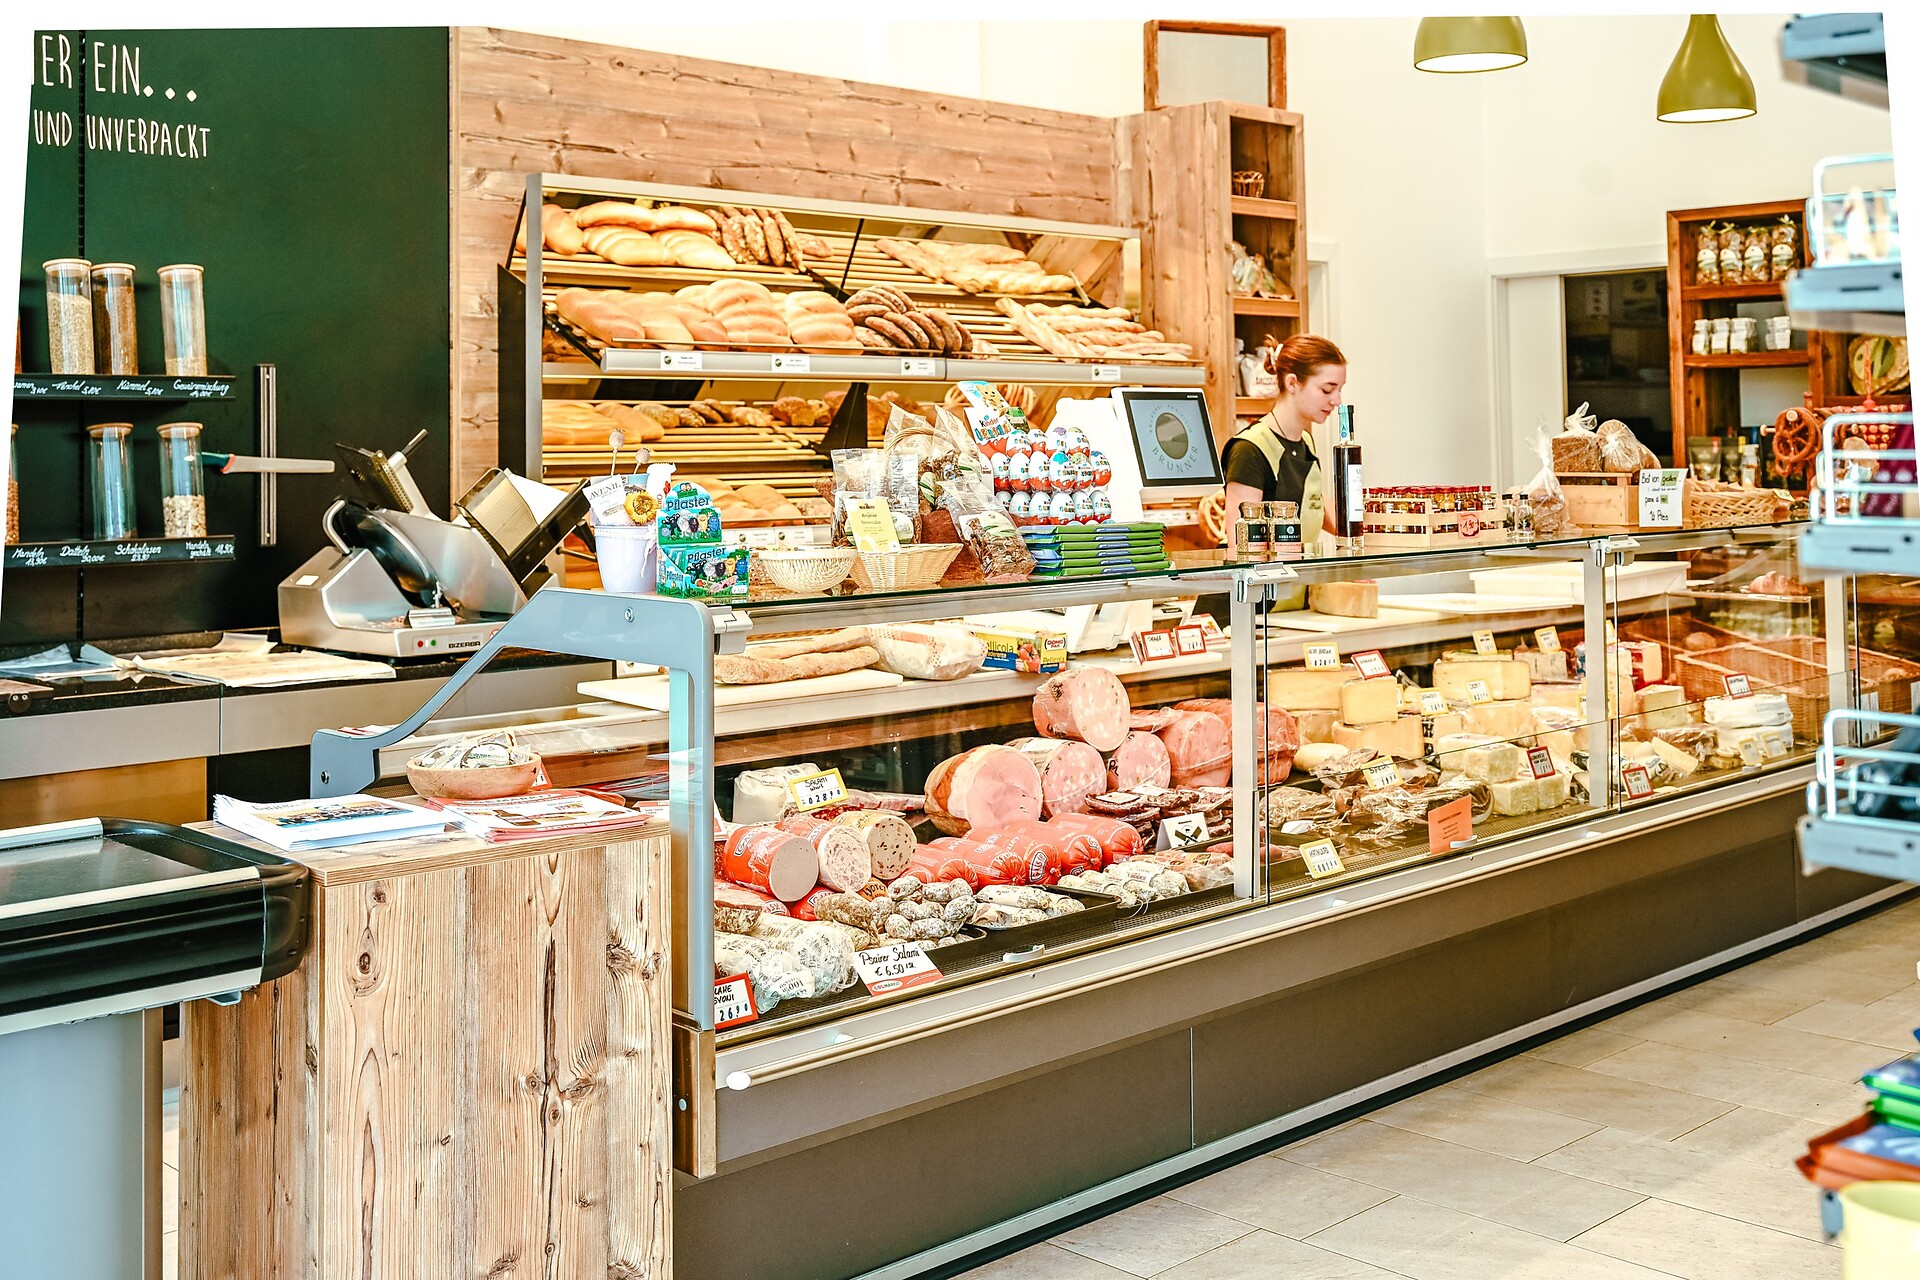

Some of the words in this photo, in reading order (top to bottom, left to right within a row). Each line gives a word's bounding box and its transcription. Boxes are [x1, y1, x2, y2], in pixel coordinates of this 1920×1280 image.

[33, 108, 73, 147] UND
[86, 114, 211, 159] UNVERPACKT
[116, 380, 151, 391] Kümmel
[1152, 445, 1199, 474] BRUNNER
[666, 495, 711, 513] Pflaster
[60, 545, 91, 557] Datteln
[687, 547, 727, 562] Pflaster
[448, 640, 481, 649] BIZERBA
[892, 944, 920, 962] Salami
[874, 966, 883, 977] €
[885, 963, 905, 977] 6.50
